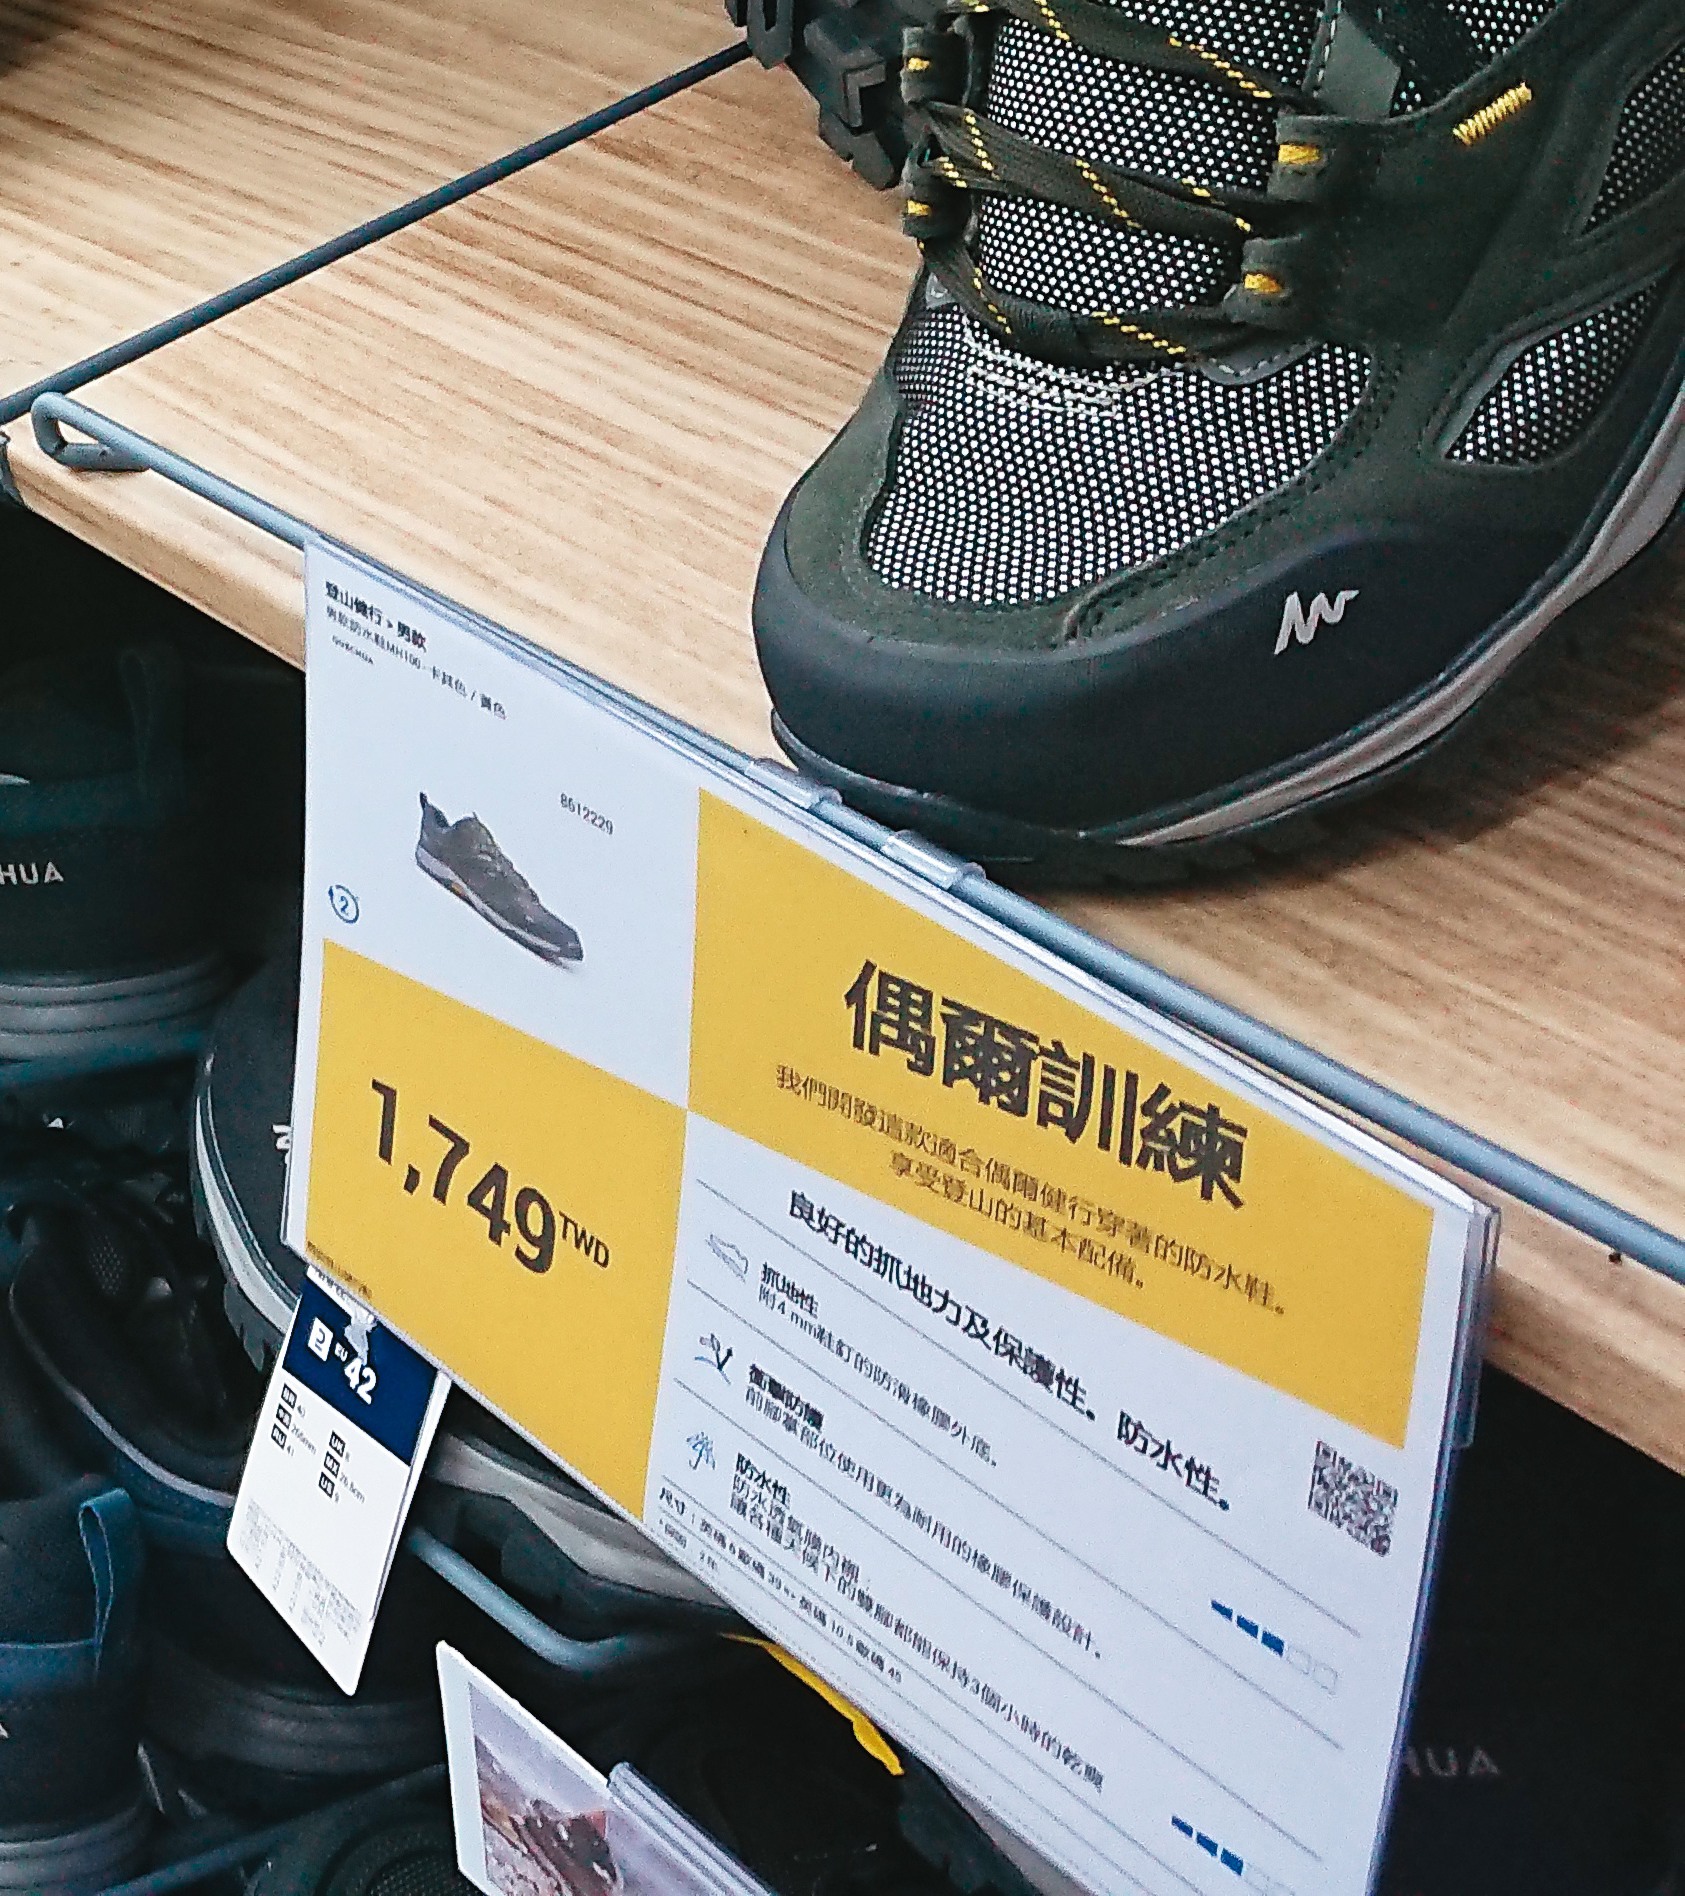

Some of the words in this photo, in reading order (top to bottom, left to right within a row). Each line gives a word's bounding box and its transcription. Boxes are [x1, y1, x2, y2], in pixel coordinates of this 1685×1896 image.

[396, 620, 427, 653] 男款
[843, 958, 1249, 1210] 偶爾訓練
[371, 1078, 557, 1275] 1,749
[558, 1210, 612, 1270] TWD
[889, 1149, 1146, 1290] 享受登山的基本配備。
[343, 1356, 378, 1406] 42
[735, 1451, 791, 1507] 防水性
